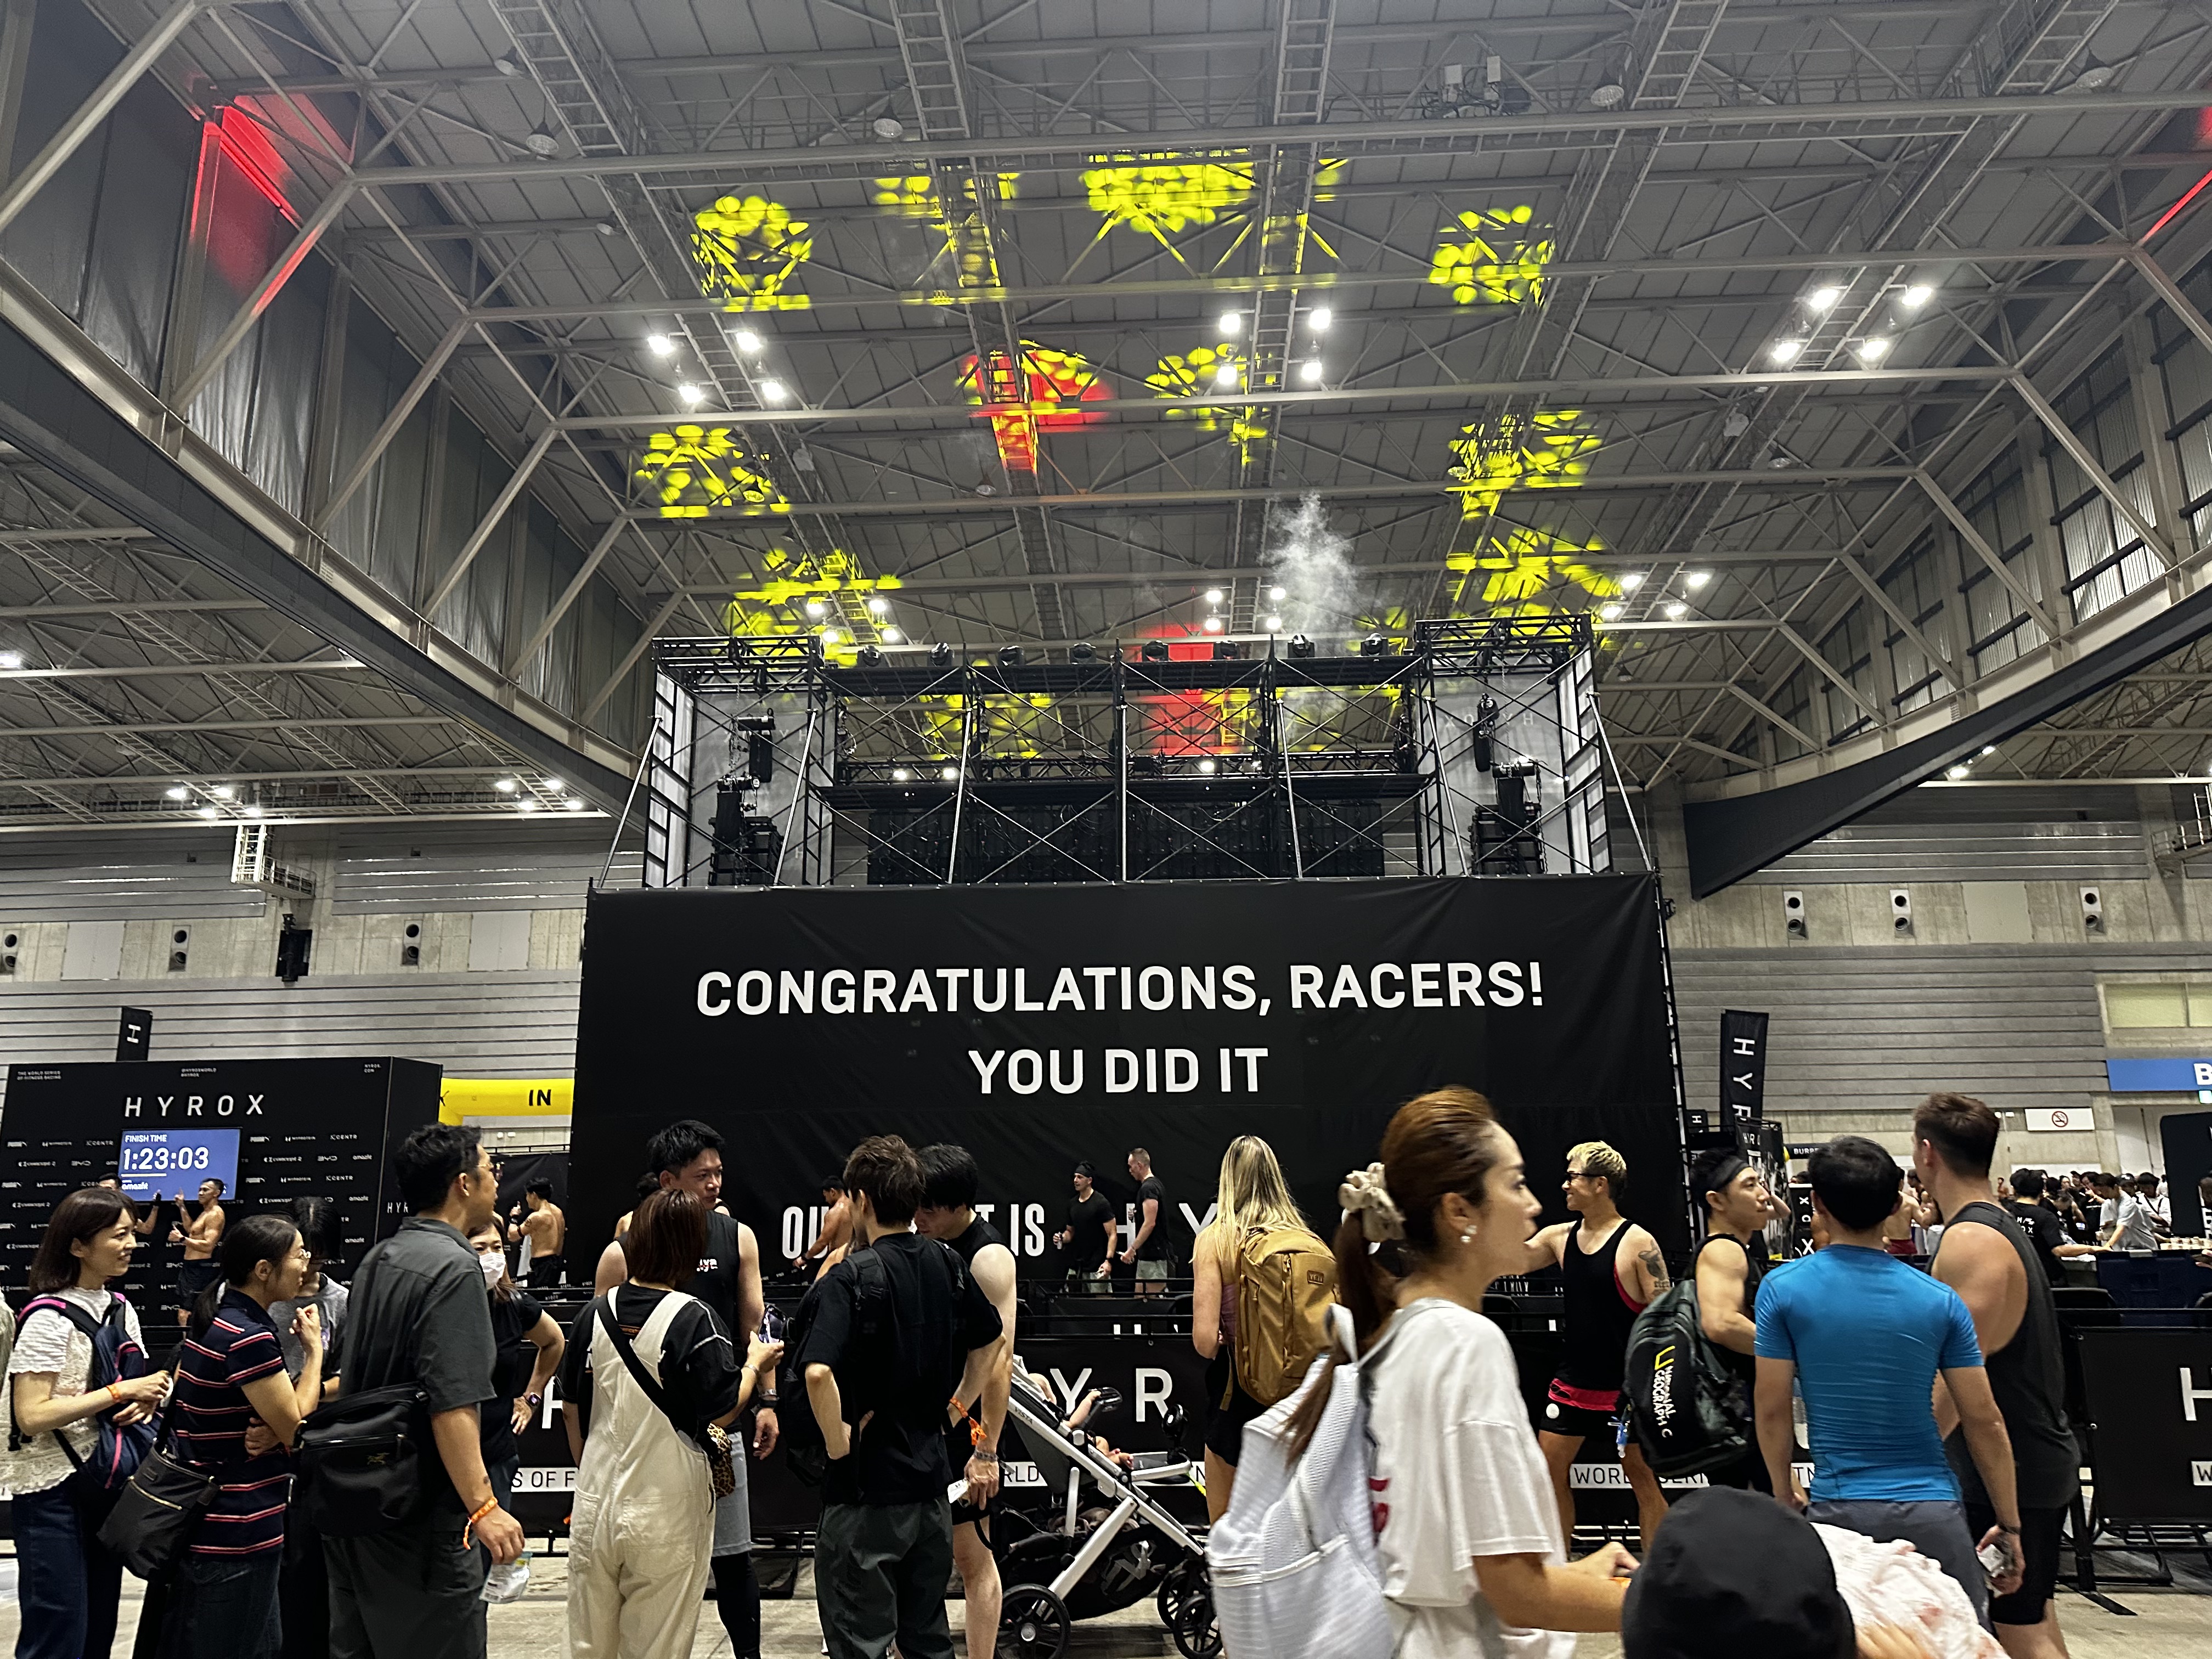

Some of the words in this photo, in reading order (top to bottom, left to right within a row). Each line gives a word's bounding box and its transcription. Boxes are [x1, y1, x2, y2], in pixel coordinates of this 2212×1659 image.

[697, 966, 1270, 1017] CONGRATULATIONS,
[1290, 961, 1543, 1008] RACERS!
[968, 1049, 1084, 1094] YOU
[1105, 1048, 1199, 1093] DID
[1220, 1048, 1268, 1092] IT
[125, 1094, 264, 1118] HYROX
[528, 1089, 551, 1107] IN
[125, 1135, 149, 1143] FINISH
[150, 1134, 167, 1142] TIME
[123, 1147, 209, 1170] 1:23:03
[1011, 1203, 1045, 1257] IS
[1652, 1369, 1674, 1438] GEOGRAPHC
[531, 1471, 557, 1488] OF
